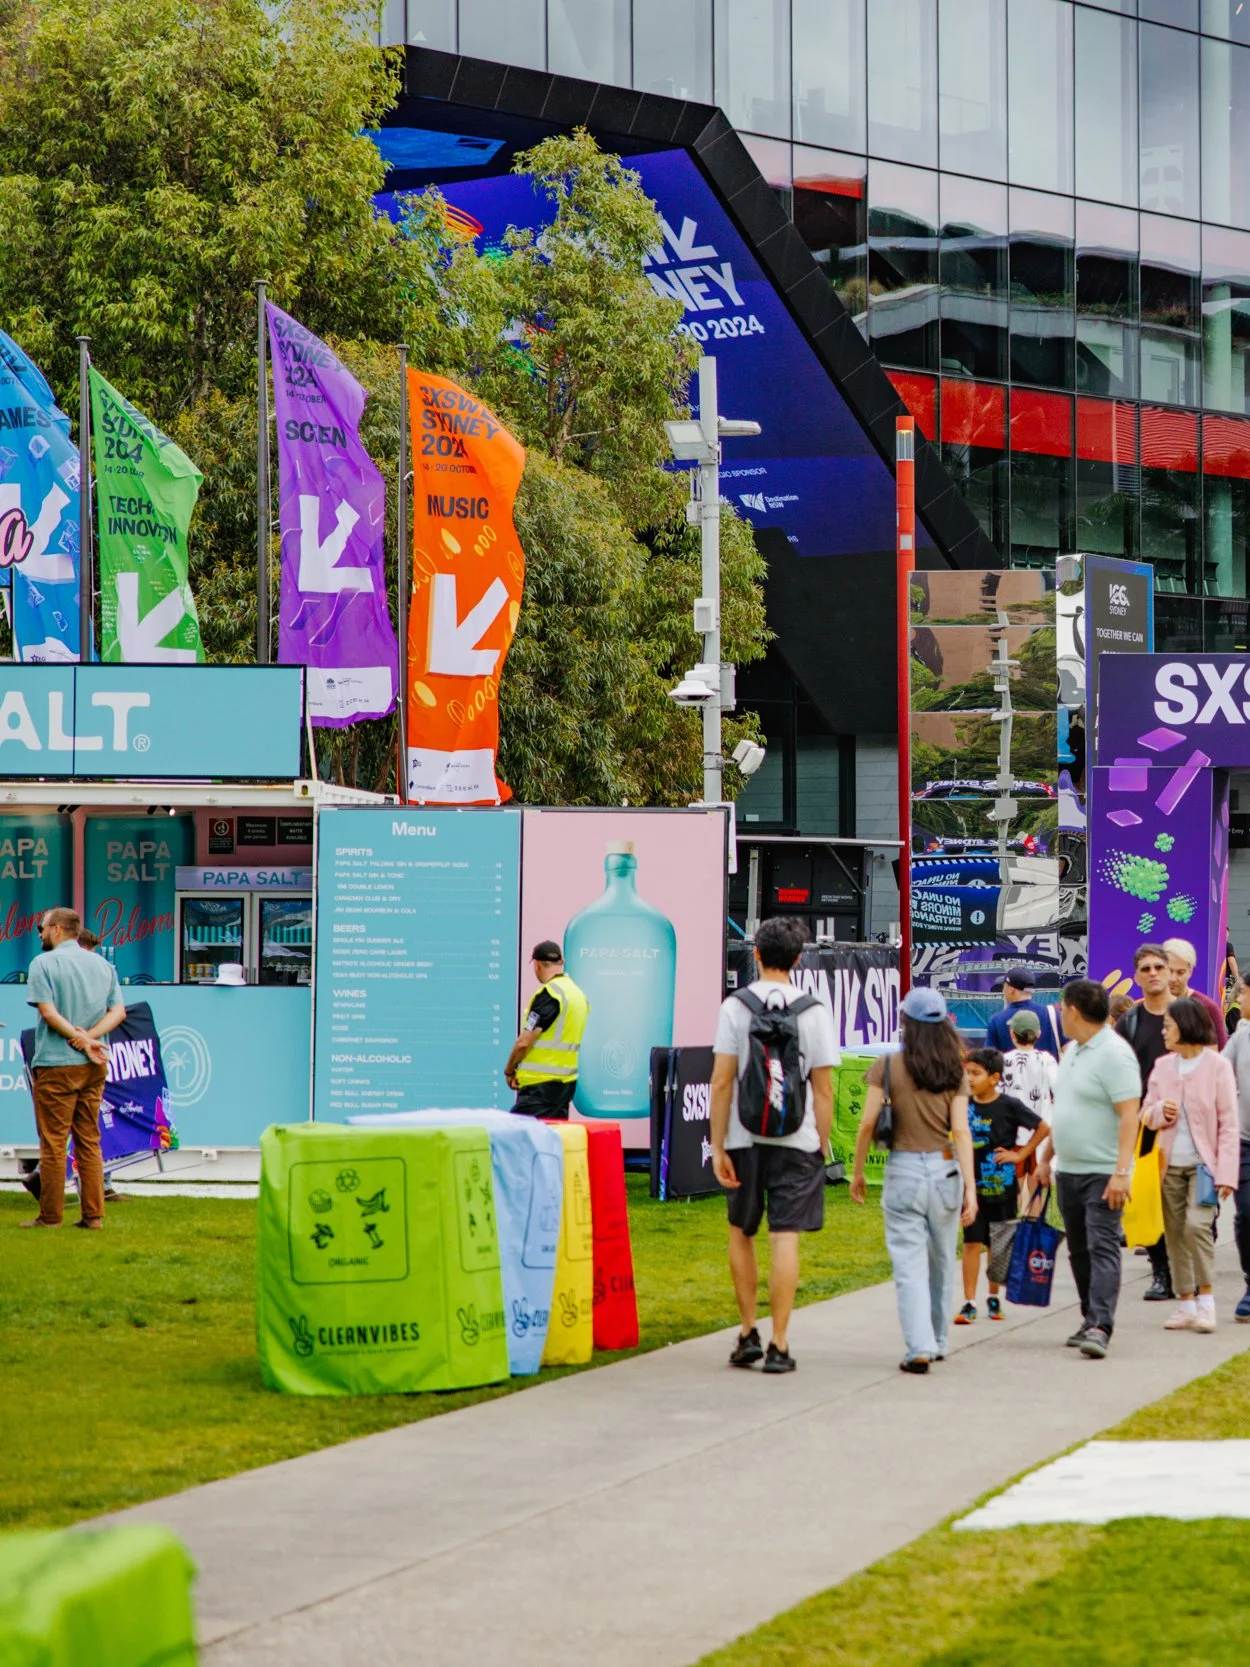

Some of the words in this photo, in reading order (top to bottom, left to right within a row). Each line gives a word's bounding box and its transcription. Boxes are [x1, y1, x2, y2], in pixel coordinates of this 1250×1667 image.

[707, 314, 765, 339] 2024
[732, 467, 767, 478] SPONSOR
[765, 494, 799, 503] Destination
[427, 494, 489, 520] MUSIC
[1109, 605, 1127, 616] SYDNEY
[1096, 628, 1122, 641] TOGETHER
[1123, 632, 1132, 642] WE
[1132, 633, 1144, 643] CAN
[392, 822, 436, 836] Menu
[0, 838, 48, 857] APA
[107, 840, 171, 860] PAPA
[335, 848, 373, 856] SPIRITS
[107, 862, 170, 882] SALT
[203, 872, 250, 885] PAPA
[256, 872, 303, 885] SALT
[333, 990, 367, 998] WINES
[331, 1055, 412, 1063] NON-ALCOHOLIC
[318, 1322, 420, 1346] CLEANVIBES
